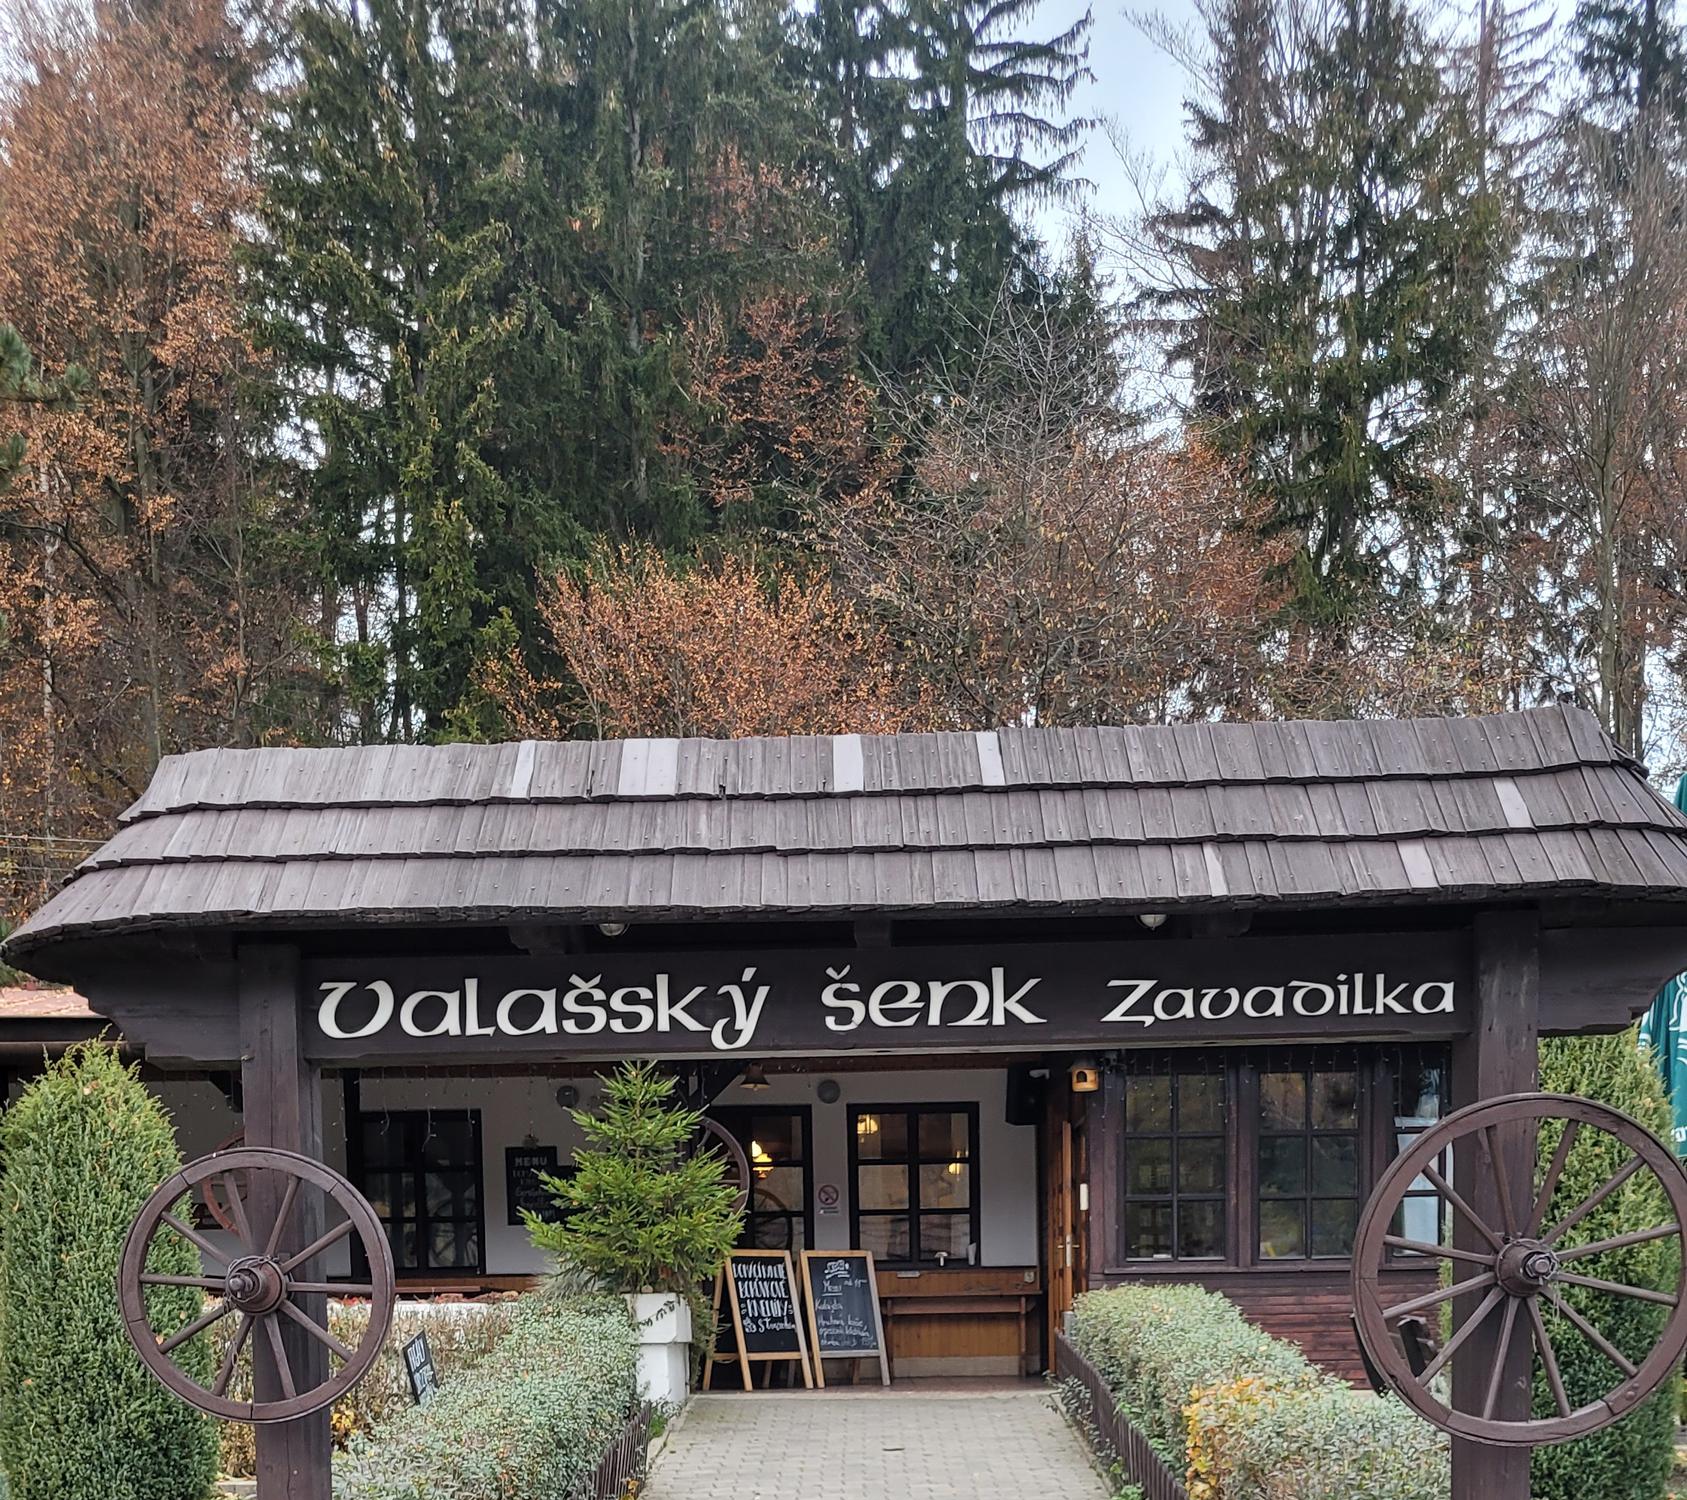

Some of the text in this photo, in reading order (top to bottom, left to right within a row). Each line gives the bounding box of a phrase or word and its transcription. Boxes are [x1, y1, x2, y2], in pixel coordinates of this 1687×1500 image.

[318, 965, 1454, 1050] Valašský šenk Zavadilka
[514, 1156, 547, 1167] MENU
